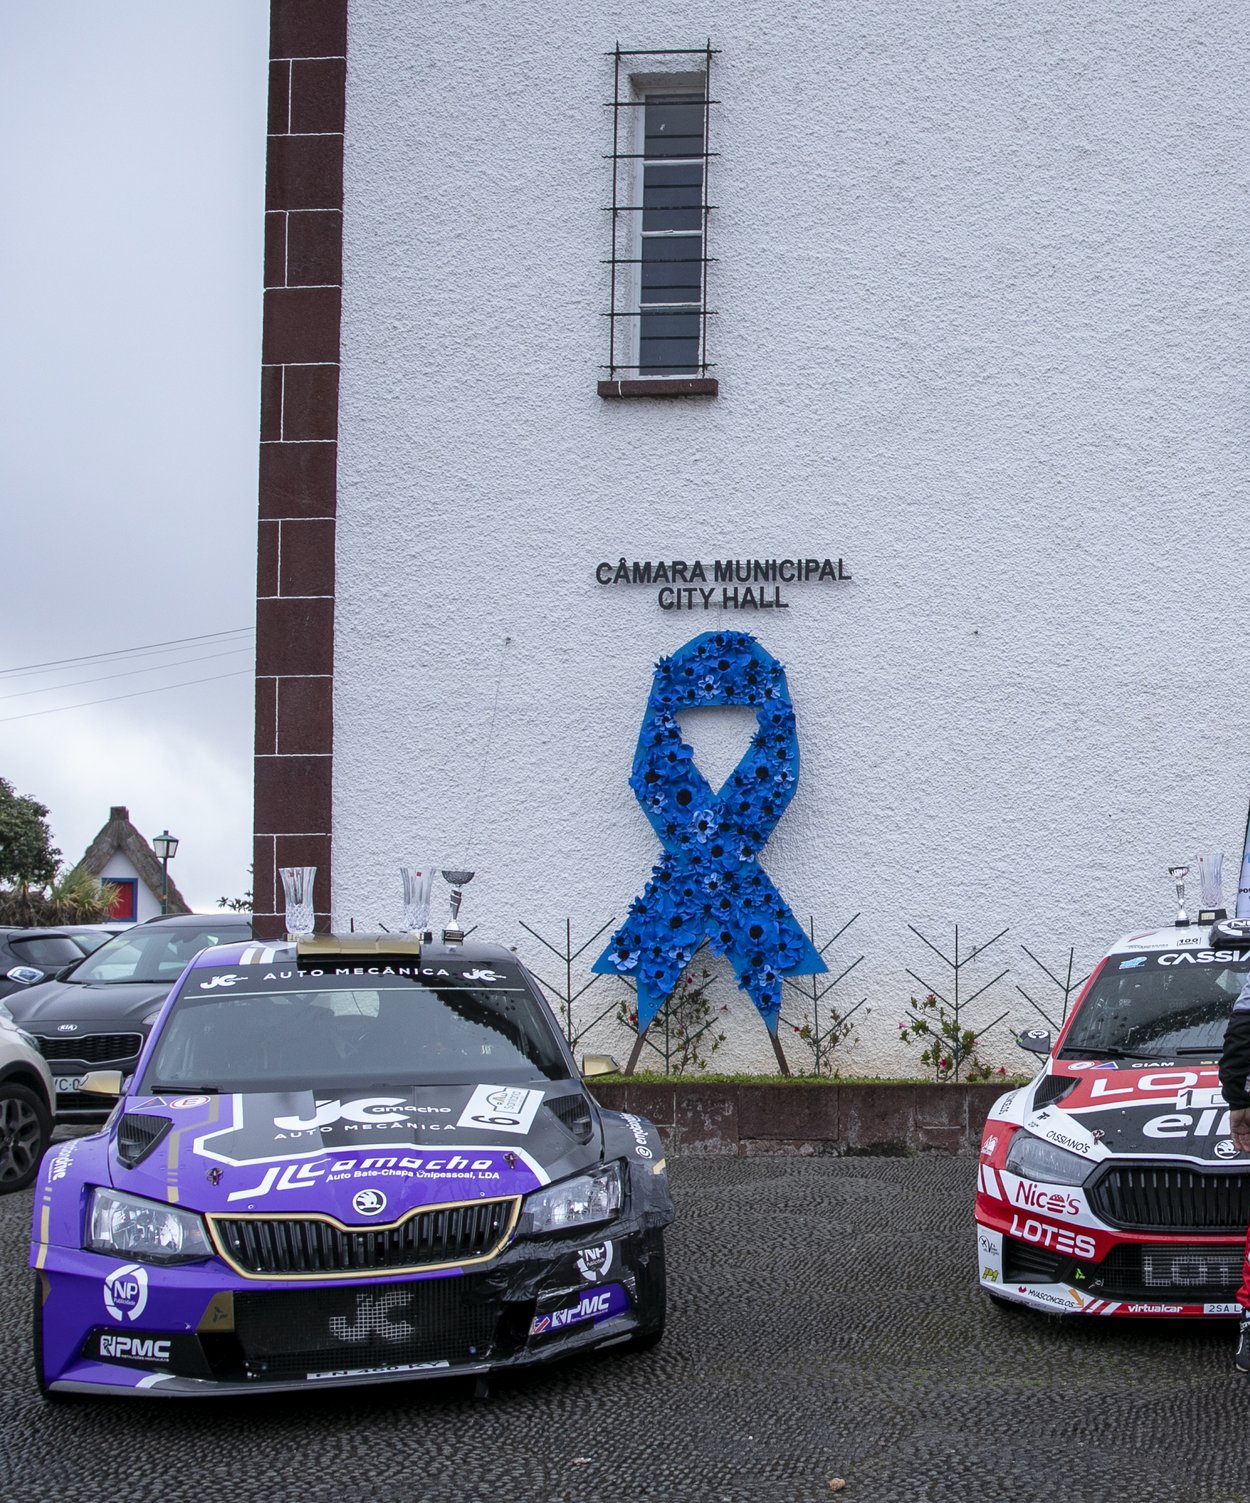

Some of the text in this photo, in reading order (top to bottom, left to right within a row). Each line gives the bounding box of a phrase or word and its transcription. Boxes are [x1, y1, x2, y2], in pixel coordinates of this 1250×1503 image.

[596, 557, 852, 584] CÂMARA MUNICIPAL
[658, 586, 789, 610] CITY HALL
[264, 969, 324, 981] AUTO
[336, 966, 450, 977] MECÂNICA
[471, 1115, 521, 1126] 6
[274, 1122, 456, 1140] AUTO MECÂNICA
[1046, 1131, 1090, 1154] CASSIANO'S
[326, 1171, 350, 1182] Auto
[353, 1169, 413, 1179] Bate-Chapa
[478, 1172, 500, 1180] LDA
[1009, 1214, 1096, 1259] LOTES
[1144, 1256, 1242, 1287] LOT
[114, 1281, 138, 1299] NP
[1028, 1289, 1075, 1308] MVASCONCELOS
[1128, 1304, 1183, 1313] virtualcar
